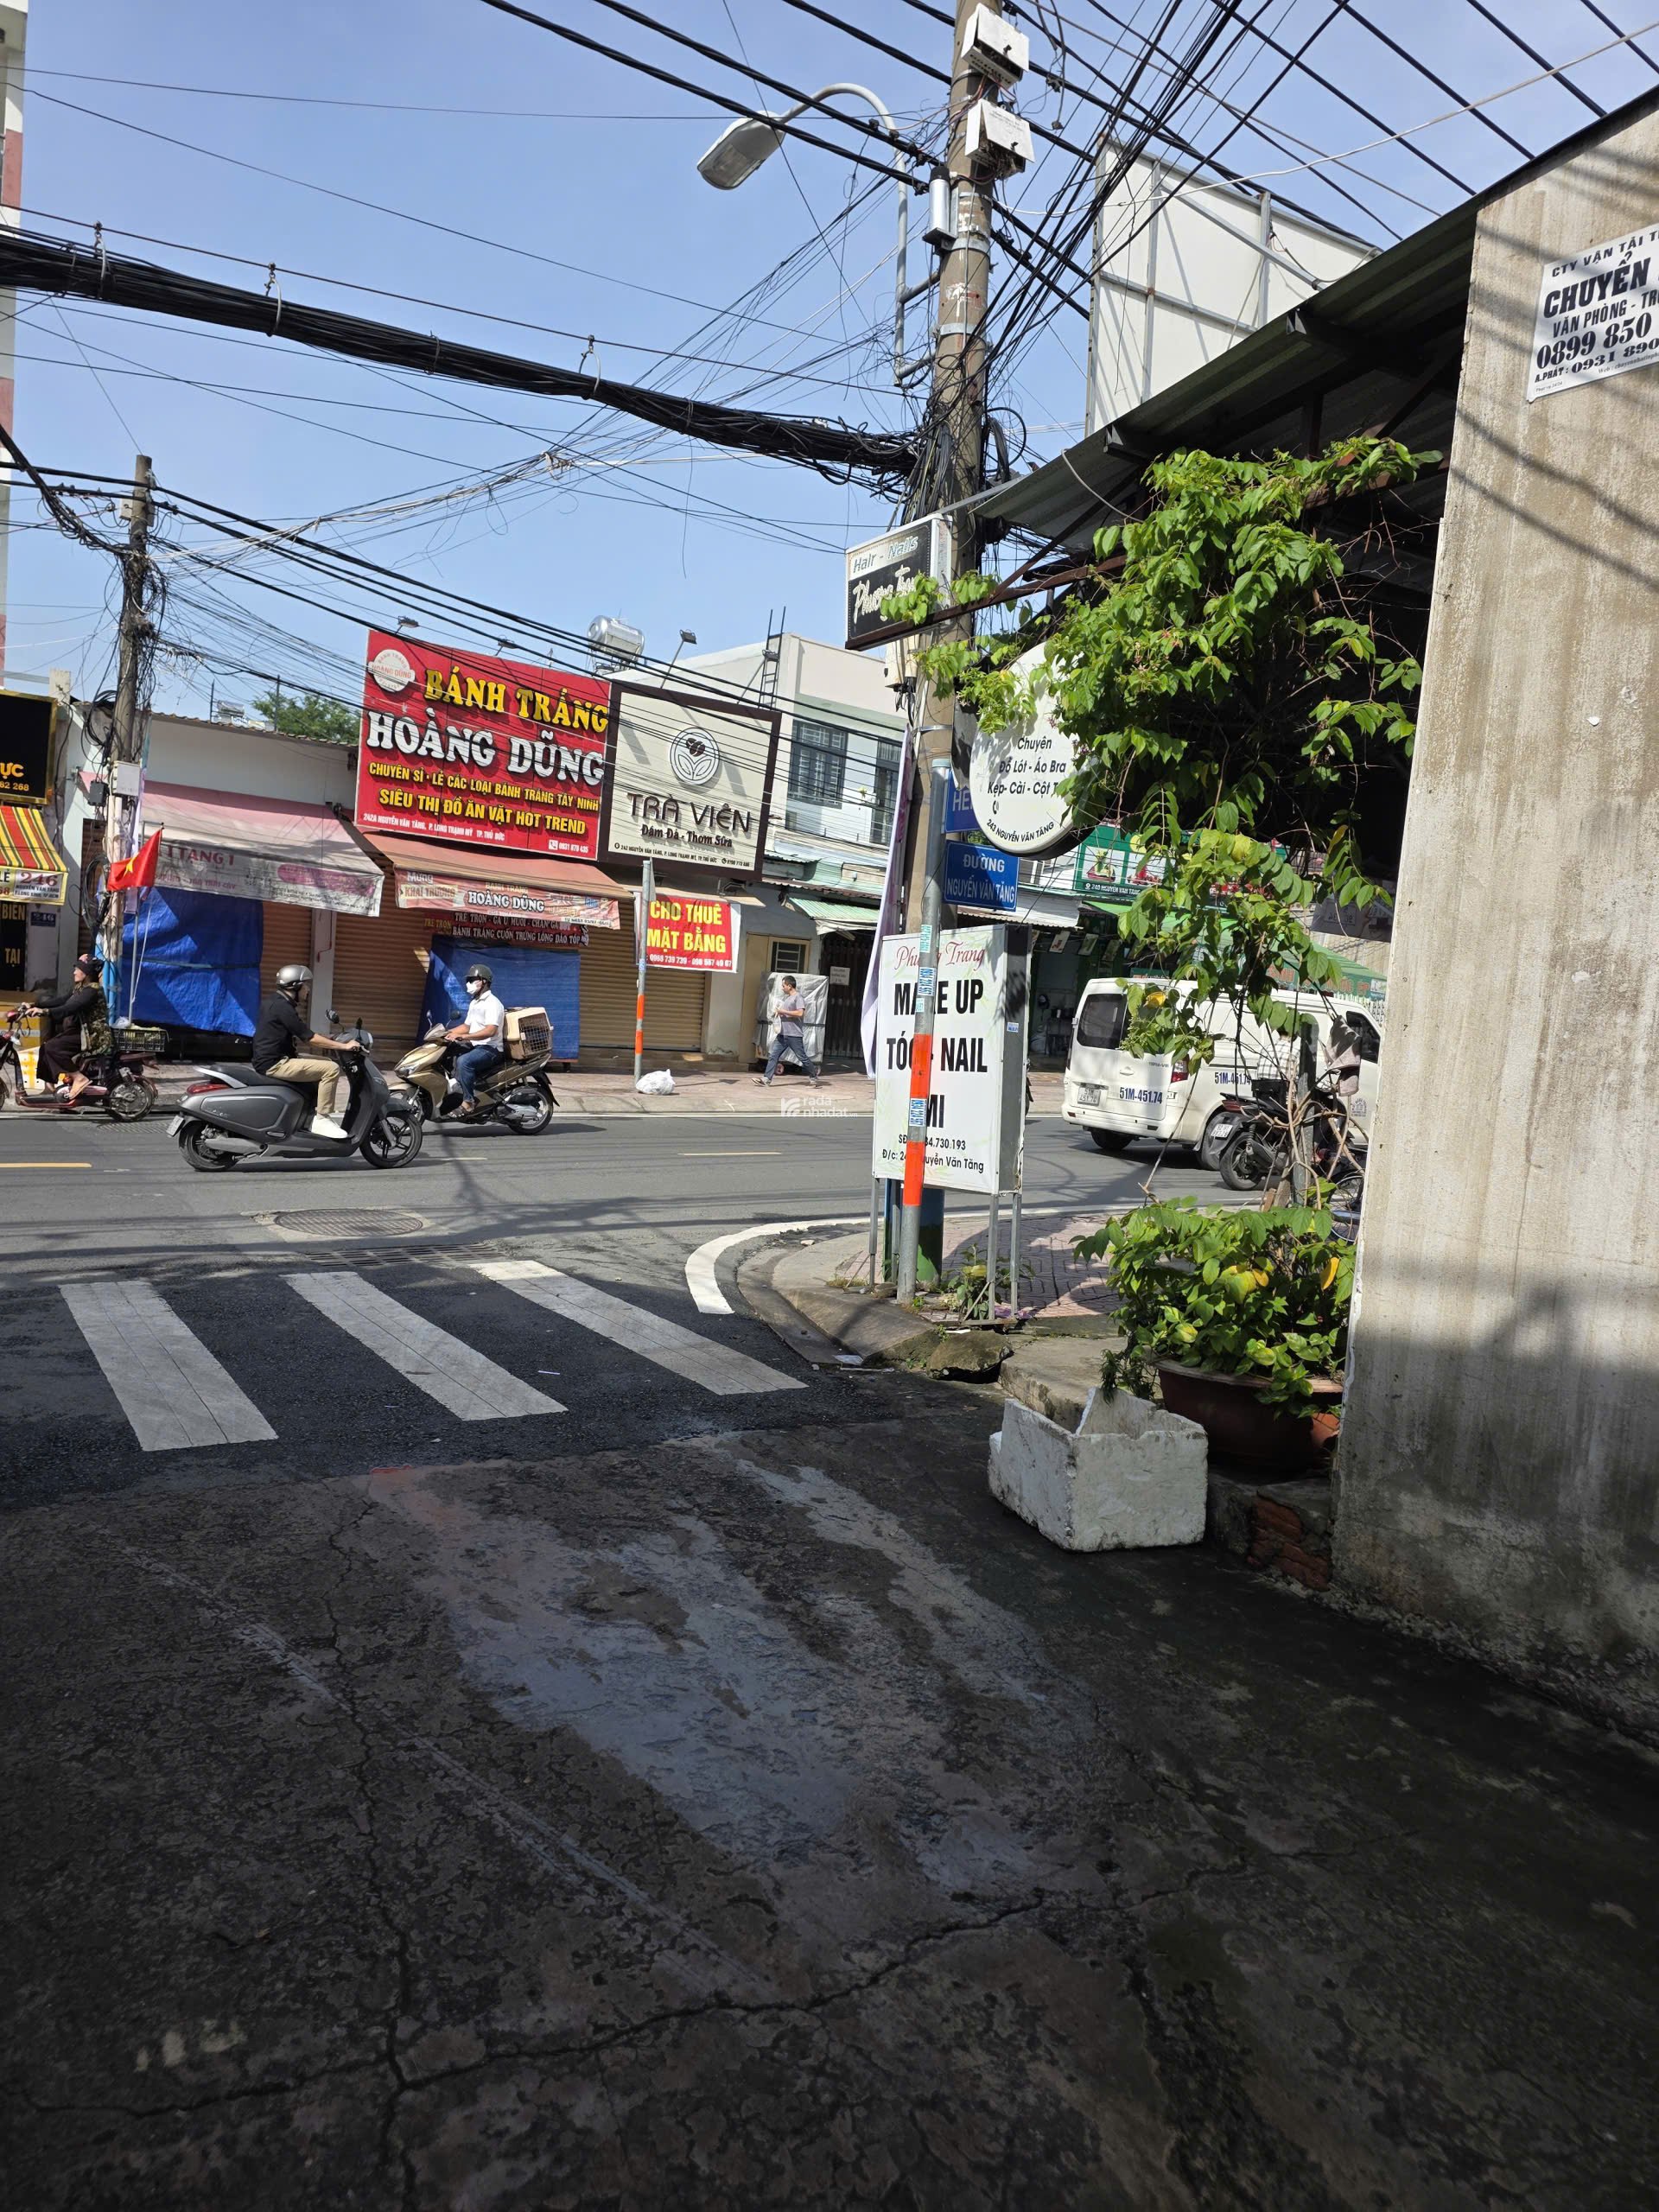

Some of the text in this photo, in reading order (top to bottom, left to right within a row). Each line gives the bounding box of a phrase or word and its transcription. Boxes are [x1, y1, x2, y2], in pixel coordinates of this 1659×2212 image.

[1551, 236, 1643, 277] CTY VẬN TẢI
[1543, 251, 1651, 319] CHUYỂN
[1553, 315, 1580, 338] VĂN
[1583, 299, 1628, 328] PHÒNG
[1536, 312, 1652, 370] 0899 850
[1571, 350, 1616, 374] 0931
[853, 535, 918, 573] Hair Nails
[423, 666, 609, 733] BÁNH TRÁNG
[366, 707, 605, 785] HOÀNG DŨNG
[1017, 735, 1052, 752] Chuyên
[1013, 760, 1027, 772] Lót
[1033, 757, 1046, 773] Áo
[1049, 760, 1066, 772] Bra
[12, 783, 29, 791] 268
[369, 762, 600, 811] CHUYÊN SỈ LẺ CÁC LOẠI BÁNH TRÁNG TÂY NINH
[1009, 781, 1026, 794] Cài
[1033, 781, 1050, 798] Cột
[379, 788, 586, 835] SIÊU THỊ ĐỒ ĂN VẶT HOT TREND
[626, 791, 751, 832] TRÀ VIÊN
[665, 827, 679, 840] Đà
[687, 830, 713, 845] Thơm
[987, 819, 1054, 842] 243 NGUYỄN VĂN TĂNG
[963, 853, 1005, 873] ĐƯỜNG
[20, 871, 58, 887] 246
[979, 879, 995, 899] VĂN
[995, 881, 1015, 904] TĂNG
[467, 889, 510, 908] HOÀNG
[512, 893, 545, 912] DŨNG
[650, 899, 723, 925] CHO THUÊ
[646, 926, 726, 953] MẶT BẰNG
[945, 941, 985, 971] Trang
[956, 978, 983, 1014] UP
[940, 1037, 988, 1073] NAIL
[1119, 1086, 1163, 1104] 51M-451.74
[945, 1156, 961, 1168] Văn
[963, 1159, 984, 1173] Tăng
